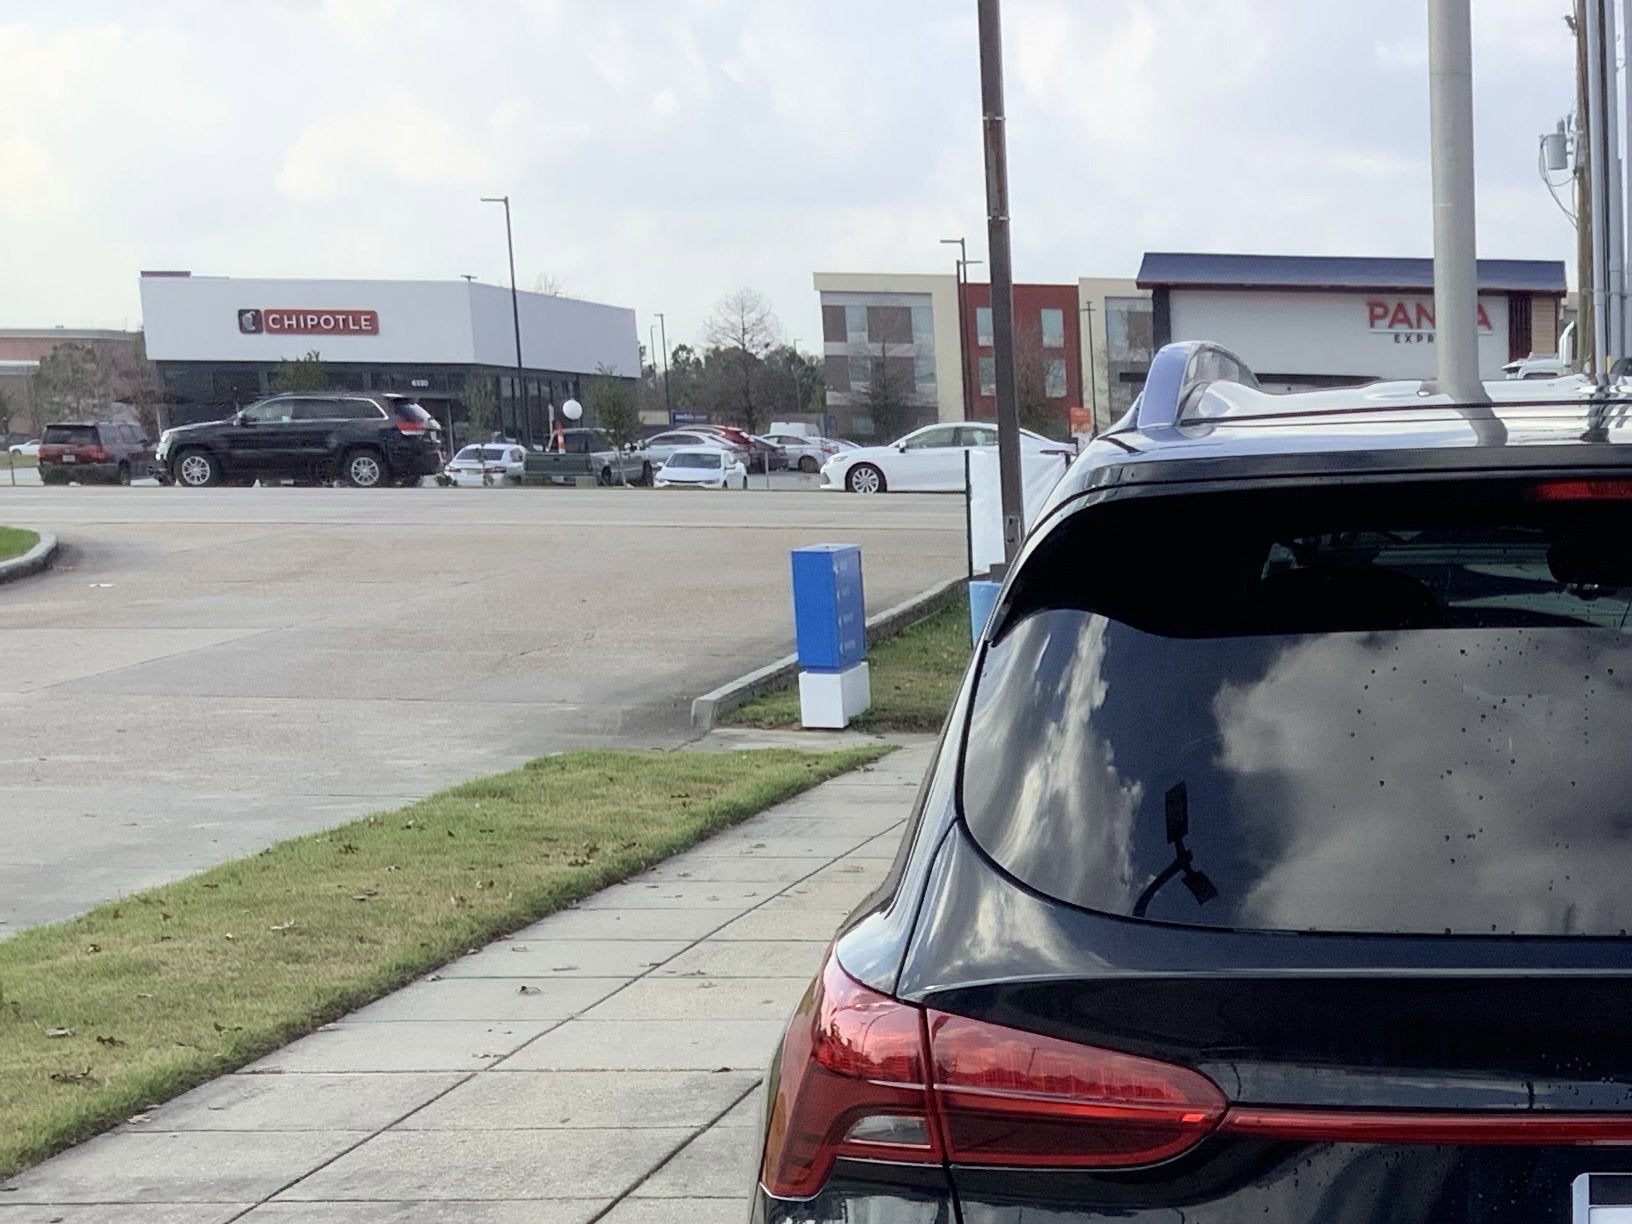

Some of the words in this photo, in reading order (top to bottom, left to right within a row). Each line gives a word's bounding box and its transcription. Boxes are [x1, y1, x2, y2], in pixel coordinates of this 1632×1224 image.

[268, 313, 373, 330] CHIPOTLE
[1366, 301, 1493, 331] PANA
[1394, 334, 1435, 344] EXPR
